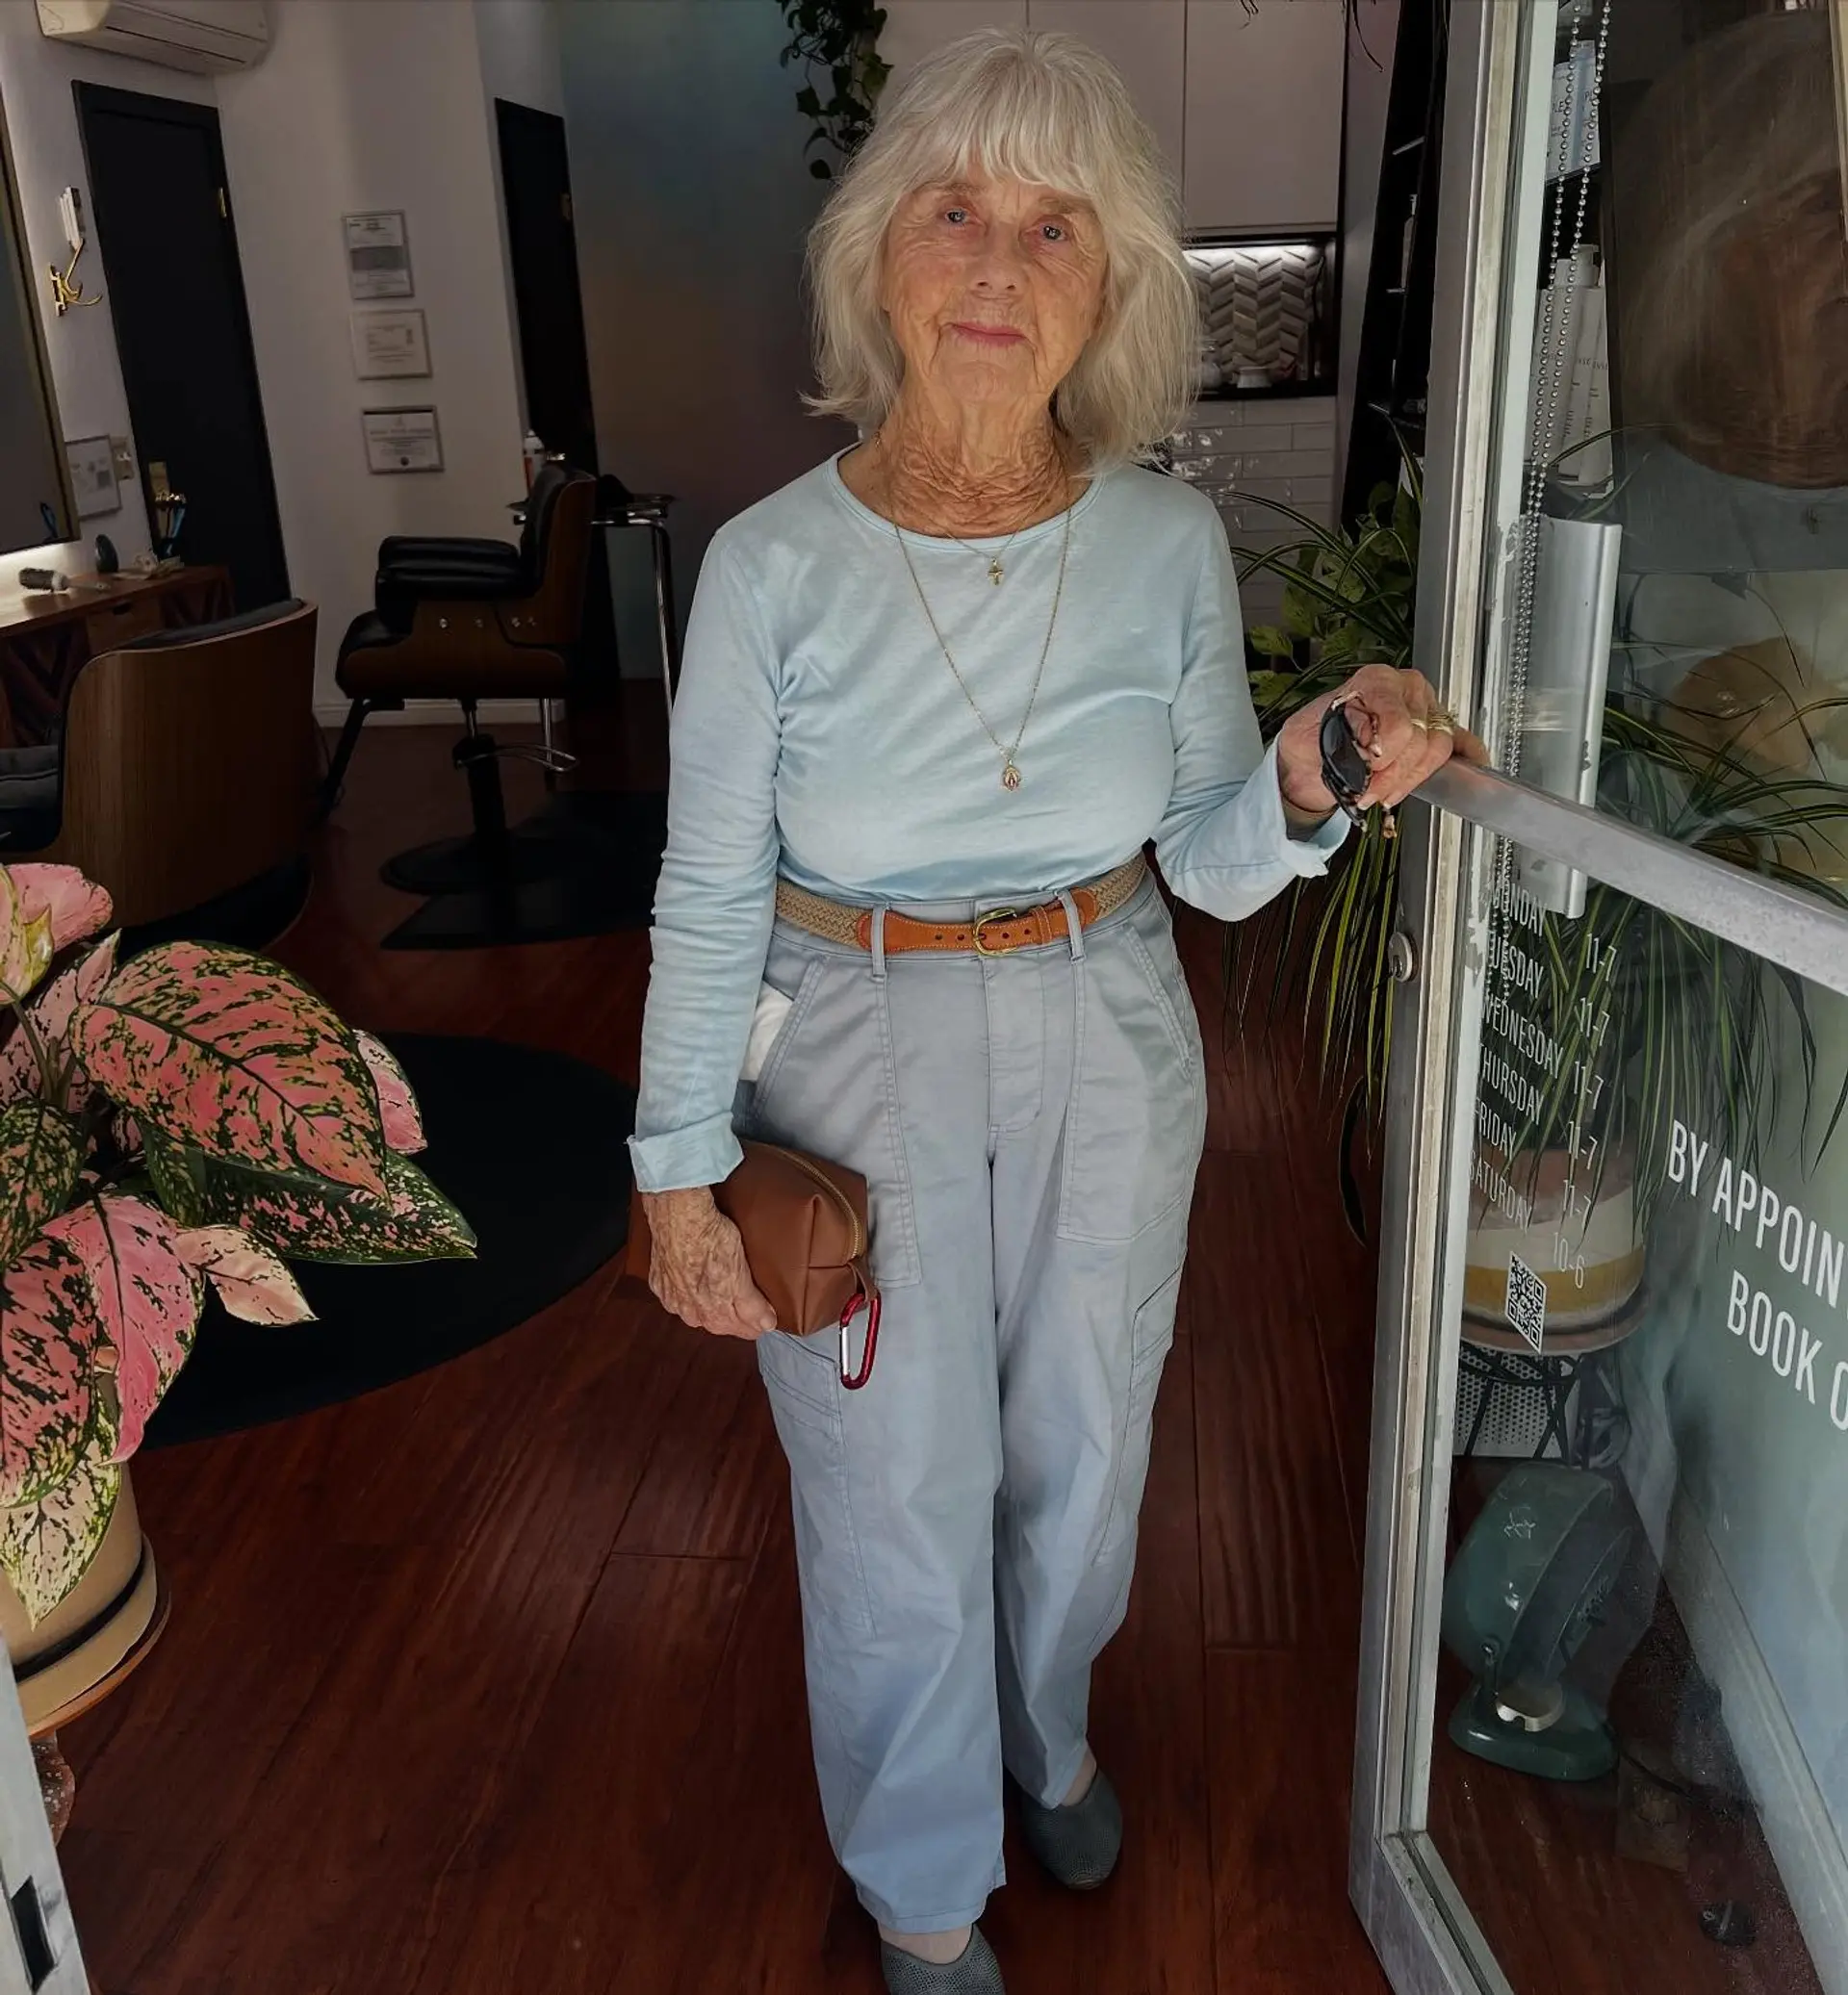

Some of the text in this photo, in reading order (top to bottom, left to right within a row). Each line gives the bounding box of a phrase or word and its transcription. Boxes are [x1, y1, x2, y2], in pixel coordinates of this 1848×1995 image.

[1585, 933, 1617, 982] 11-7
[1579, 997, 1610, 1047] 11-7
[1479, 1042, 1545, 1126] HURSDAY
[1668, 1119, 1708, 1197] BY
[1553, 1232, 1585, 1290] 10-6
[1727, 1268, 1823, 1405] BOOK
